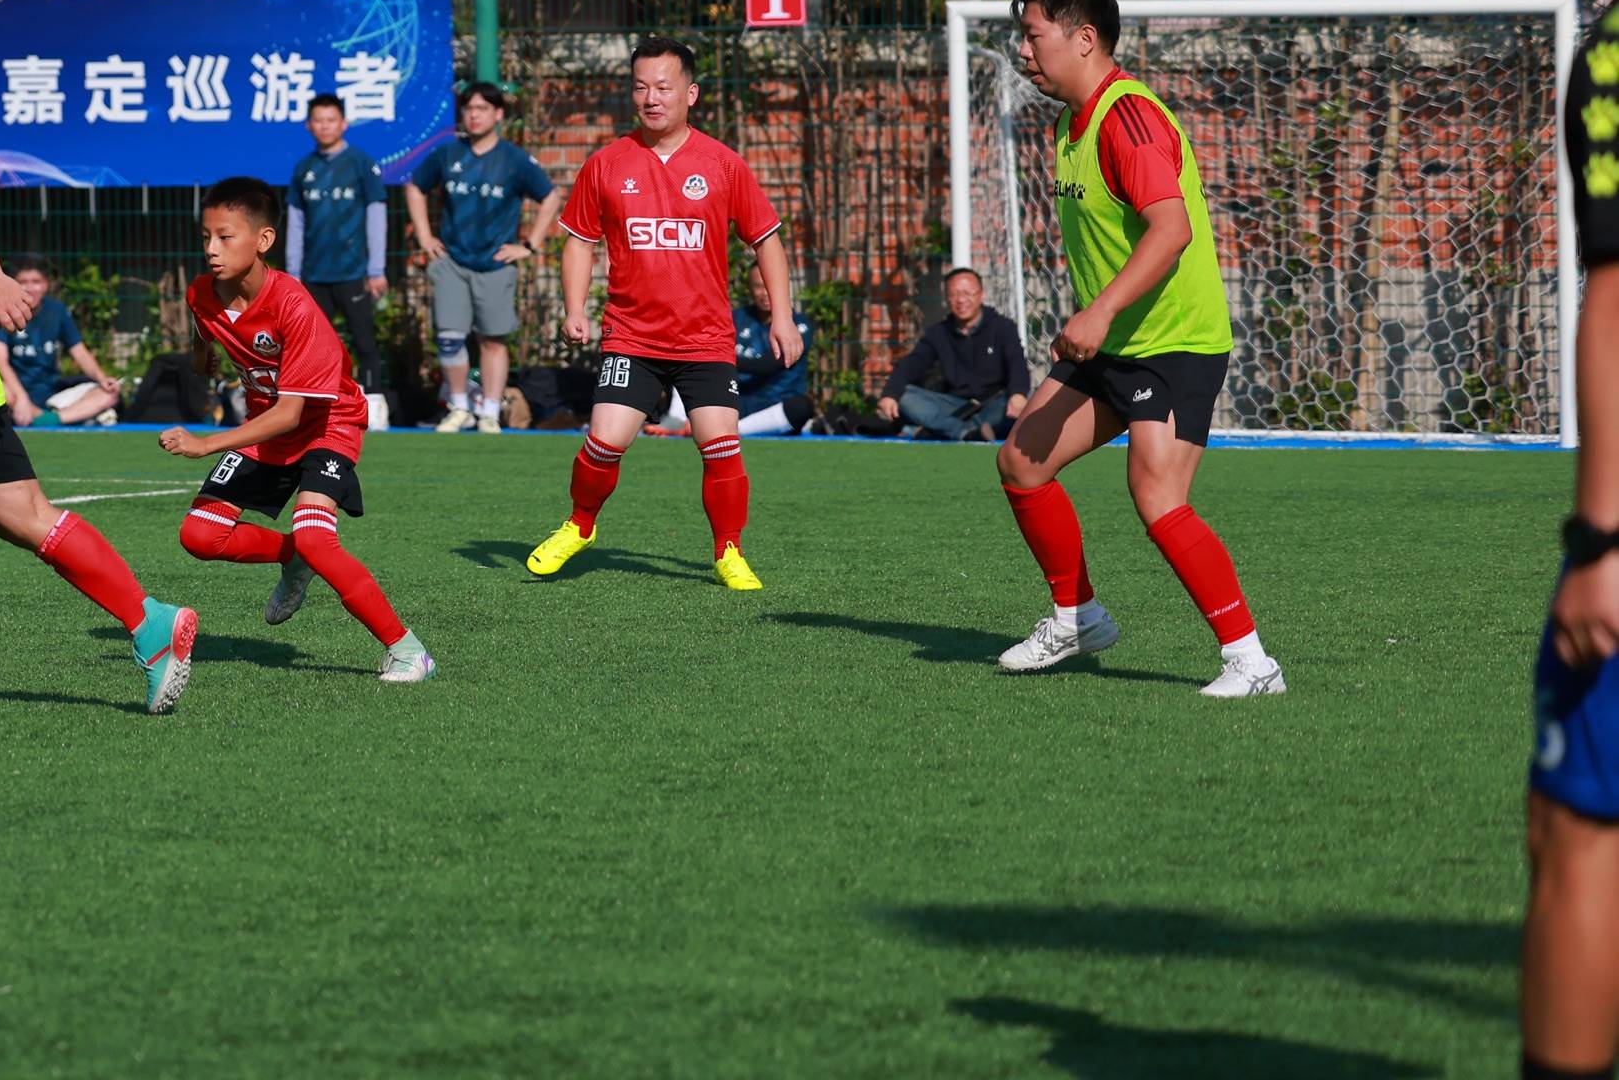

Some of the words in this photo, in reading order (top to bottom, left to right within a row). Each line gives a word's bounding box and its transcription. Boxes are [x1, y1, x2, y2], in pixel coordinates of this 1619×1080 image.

[1, 52, 401, 126] 嘉定巡游者
[626, 218, 706, 251] SCM
